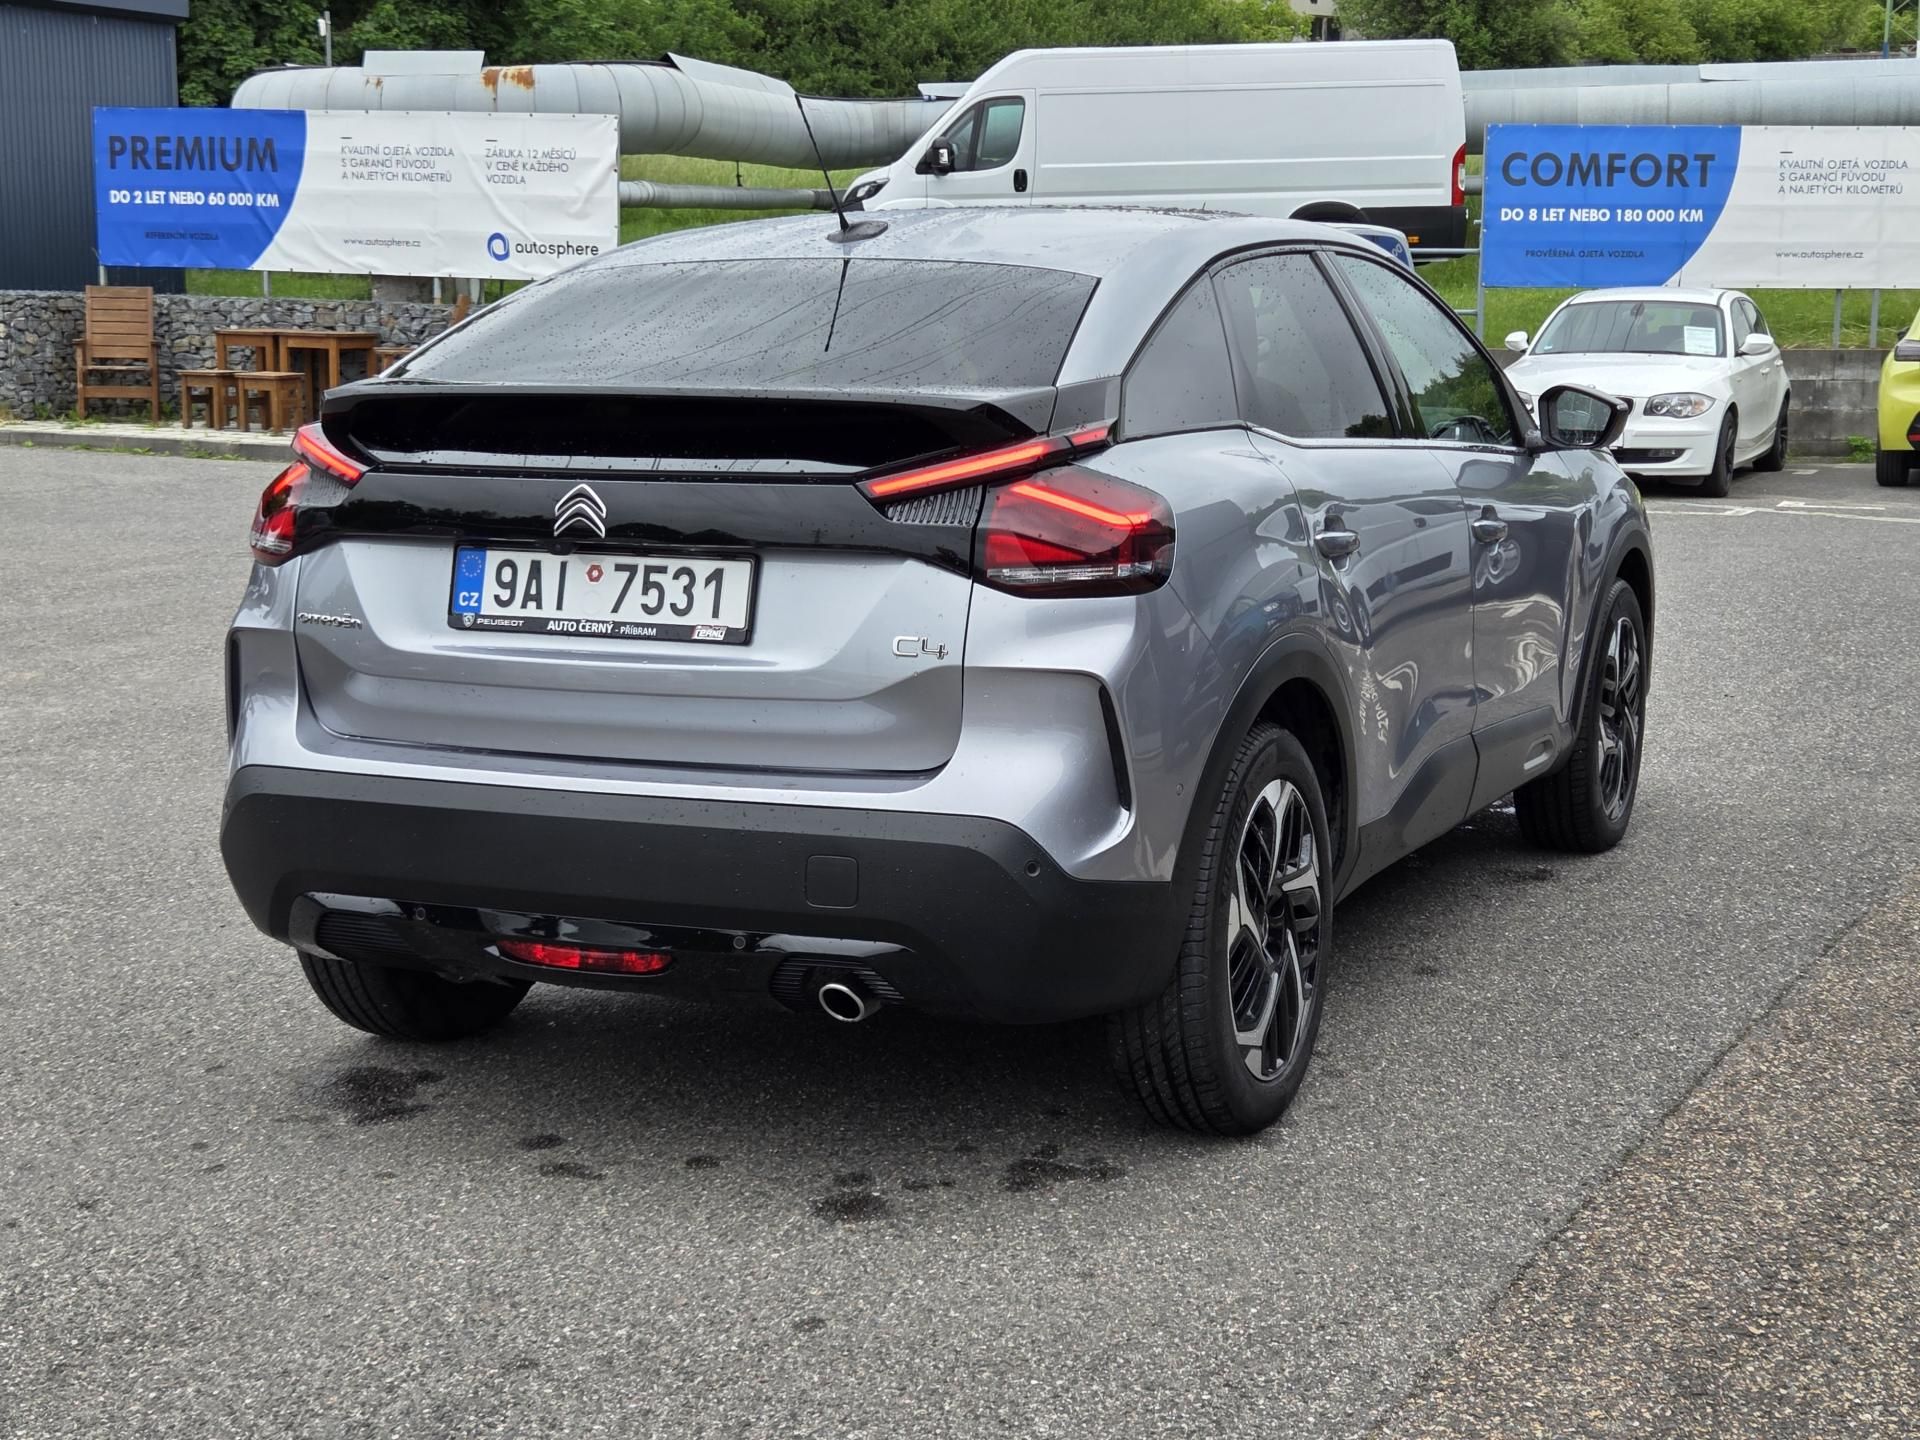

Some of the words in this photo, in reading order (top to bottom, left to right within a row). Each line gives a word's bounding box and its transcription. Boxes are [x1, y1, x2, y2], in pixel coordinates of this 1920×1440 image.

[109, 135, 279, 172] PREMIUM
[341, 144, 380, 156] KVALITNÍ
[383, 145, 413, 157] OJETÁ
[416, 147, 455, 157] VOZIDLA
[486, 147, 525, 159] ZÁRUKA
[528, 149, 538, 159] 12
[542, 148, 577, 160] MĚSÍCŮ
[341, 158, 347, 168] S
[350, 156, 393, 168] GARANCÍ
[396, 157, 436, 169] PŮVODU
[486, 162, 493, 171] V
[496, 159, 520, 172] CENĚ
[522, 159, 569, 173] KAŽDÉHO
[1780, 158, 1824, 169] KVALITNÍ
[1827, 158, 1859, 169] OJETÁ
[1864, 159, 1908, 169] VOZIDLA
[342, 171, 349, 180] A
[351, 169, 399, 182] NAJETÝCH
[1502, 151, 1716, 188] COMFORT
[1779, 172, 1785, 182] S
[1788, 170, 1838, 182] GARANCÍ
[1841, 169, 1886, 182] PŮVODU
[486, 174, 526, 185] VOZIDLA
[1778, 185, 1786, 194] A
[1789, 183, 1842, 194] NAJETÝCH
[1846, 182, 1903, 195] KILOMETRŮ
[109, 190, 131, 204] DO
[134, 190, 142, 204] 2
[146, 191, 165, 204] LET
[169, 192, 205, 206] NEBO
[209, 192, 225, 206] 60
[228, 193, 253, 206] 000
[256, 194, 280, 207] KM
[1501, 208, 1524, 222] DO
[1529, 208, 1538, 221] 8
[1542, 208, 1565, 222] LET
[1569, 208, 1611, 222] NEBO
[1616, 208, 1643, 222] 180
[1646, 209, 1675, 222] 000
[1679, 209, 1704, 222] KM
[343, 238, 421, 248] www.autosphere.cz
[515, 241, 599, 259] autosphere
[1578, 249, 1605, 258] OJETÁ
[1608, 250, 1645, 258] VOZIDLA
[1775, 251, 1864, 260] www.autosphere.cz
[610, 563, 725, 619] 7531
[458, 591, 479, 607] CZ
[476, 618, 525, 627] PEUGEOT
[547, 620, 576, 632] AUTO
[578, 619, 613, 634] ČERNÝ
[620, 626, 657, 636] PŘÍBRAM
[892, 635, 949, 660] C4
